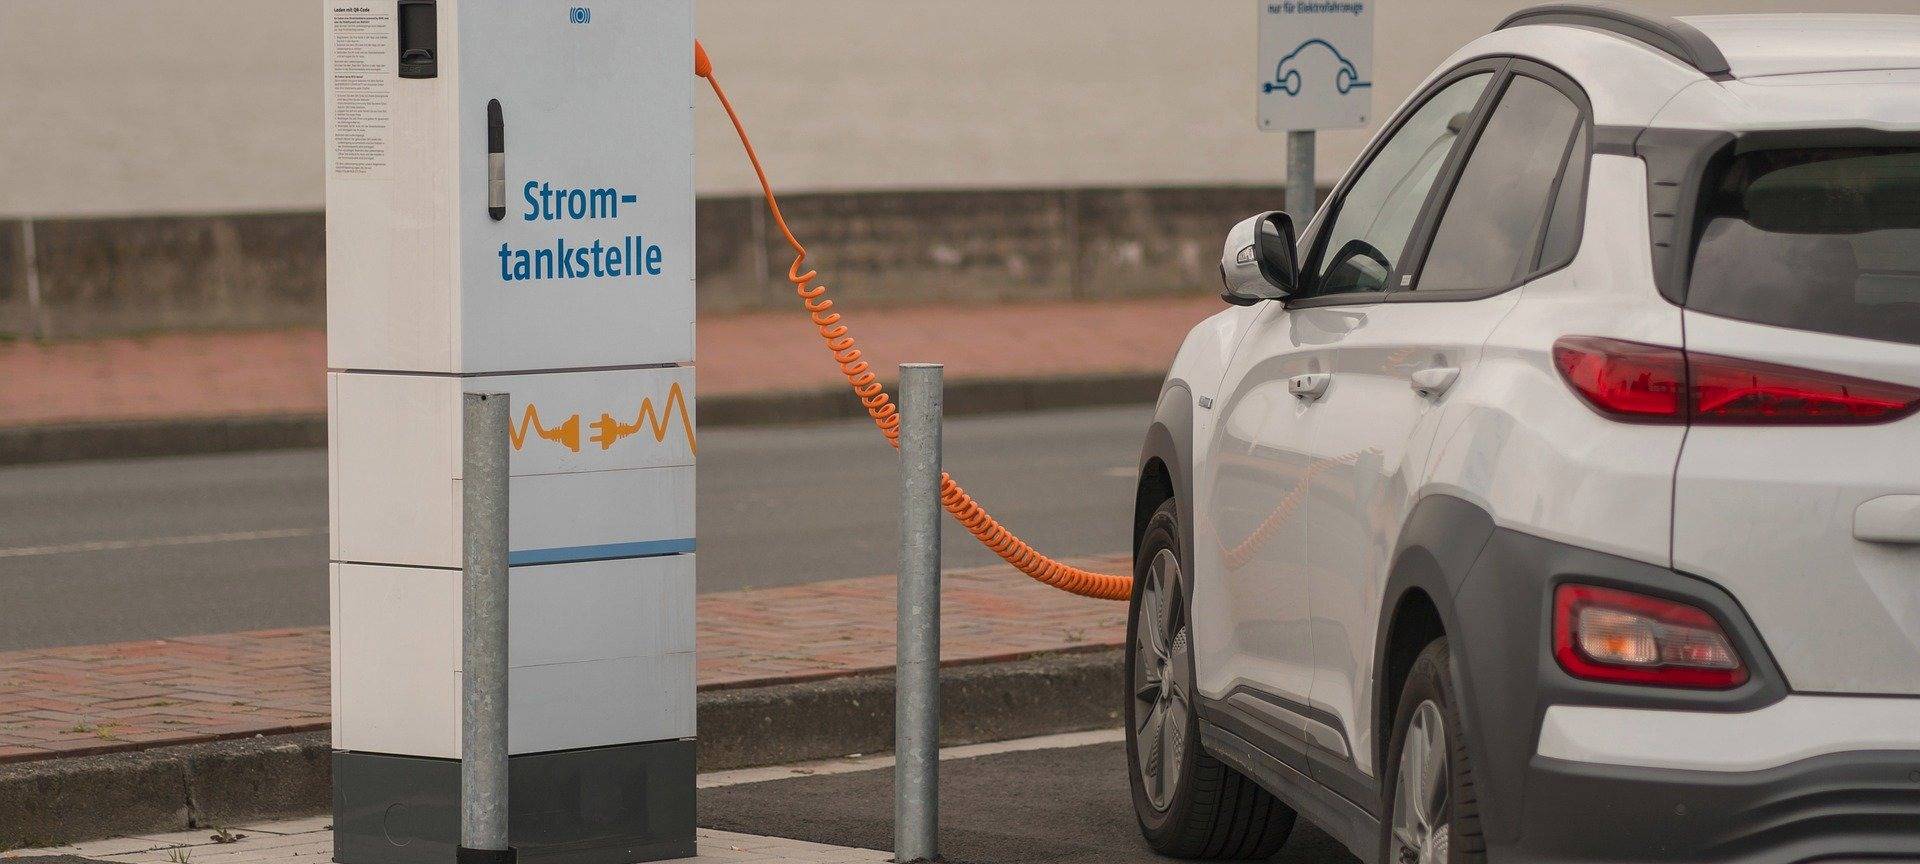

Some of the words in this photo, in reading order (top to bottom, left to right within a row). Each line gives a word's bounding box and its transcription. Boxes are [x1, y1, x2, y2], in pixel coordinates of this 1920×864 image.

[1267, 4, 1281, 14] nur
[1283, 1, 1295, 13] für
[1297, 2, 1363, 16] Elektrofahrzeuge
[524, 180, 637, 221] Strom-
[498, 236, 662, 281] tankstelle
